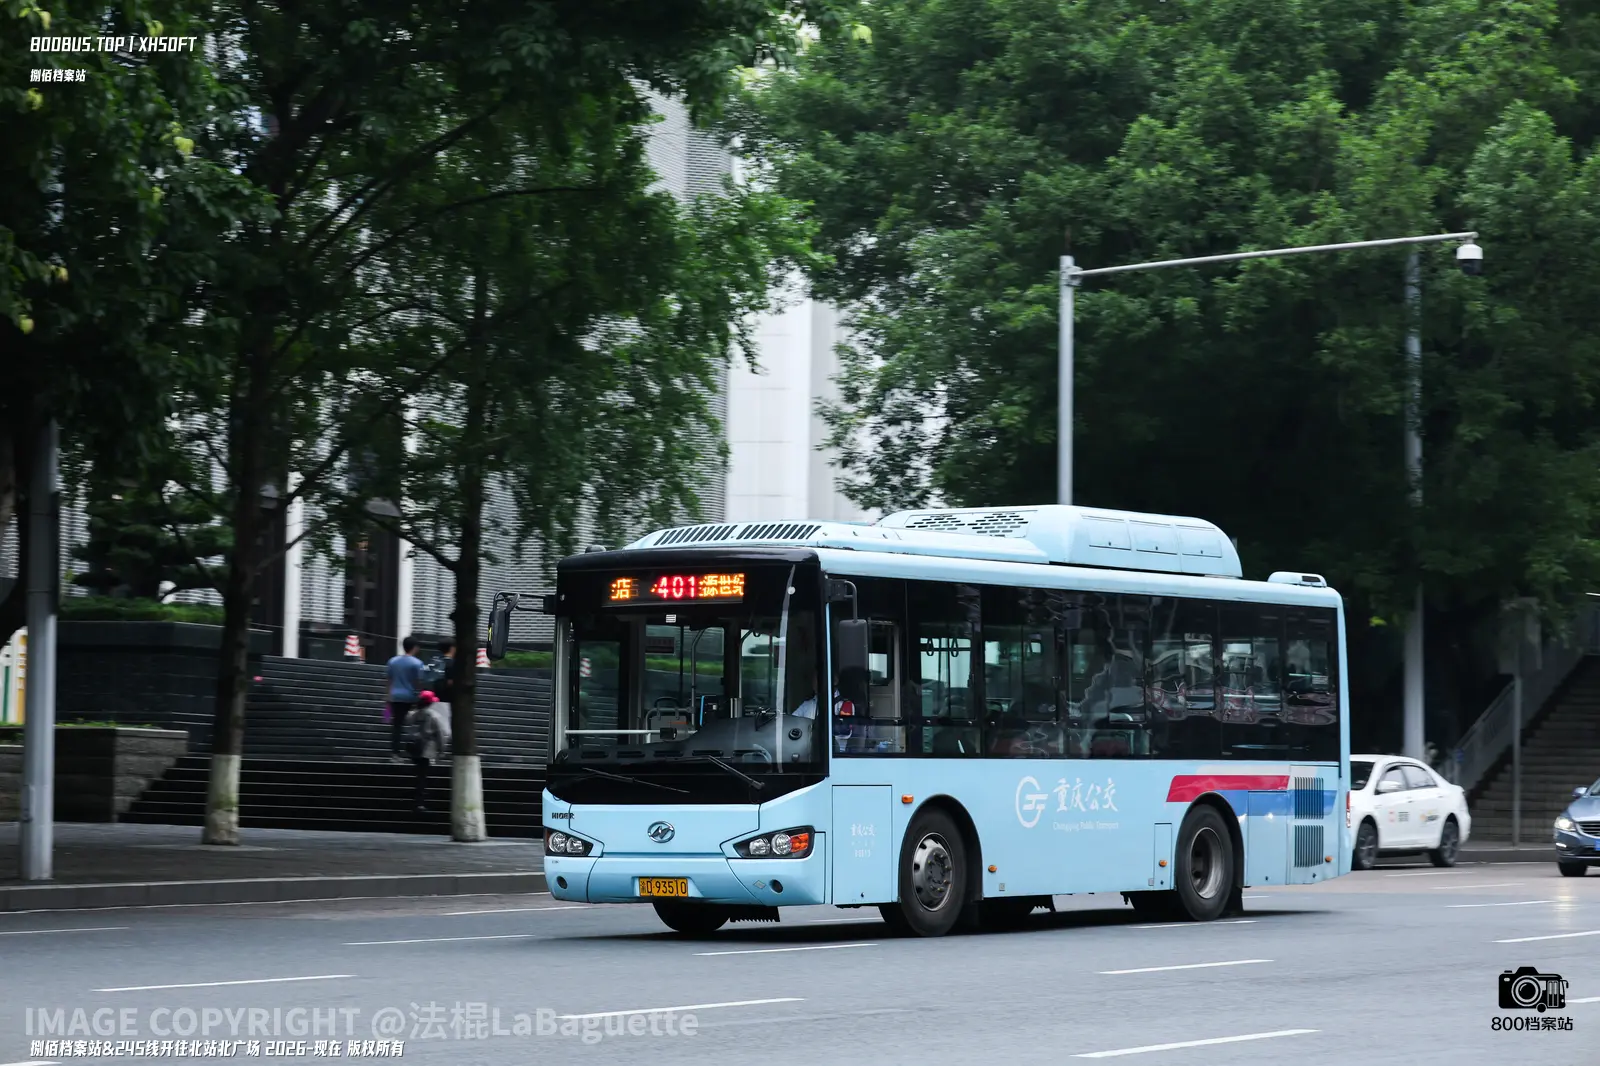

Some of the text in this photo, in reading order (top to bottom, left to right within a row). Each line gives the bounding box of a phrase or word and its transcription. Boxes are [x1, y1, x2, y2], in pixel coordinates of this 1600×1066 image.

[658, 576, 696, 599] 401
[1053, 777, 1119, 813] 重庆公交
